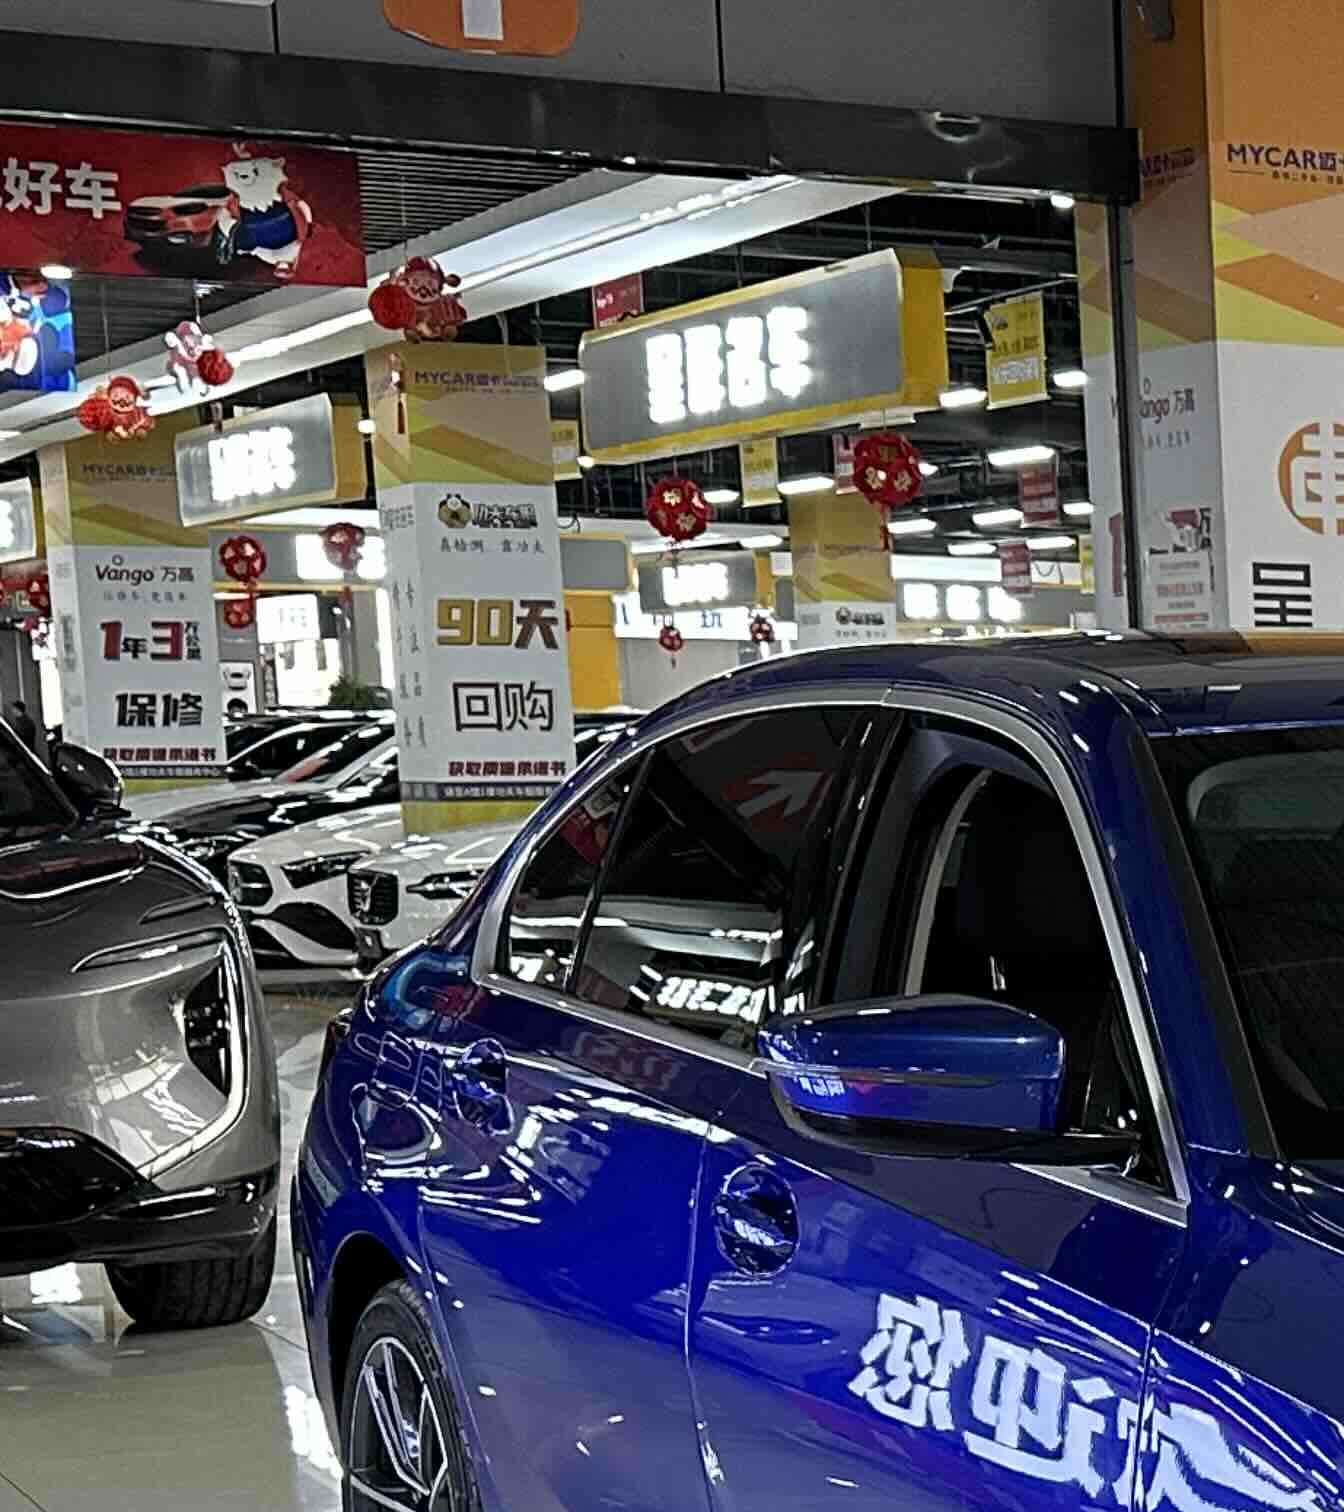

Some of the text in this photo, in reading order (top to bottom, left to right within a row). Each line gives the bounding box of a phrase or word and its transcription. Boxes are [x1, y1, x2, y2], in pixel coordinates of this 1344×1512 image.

[95, 564, 155, 586] Vango
[437, 598, 559, 650] 90天
[115, 692, 203, 728] 保修
[452, 681, 554, 732] 回购
